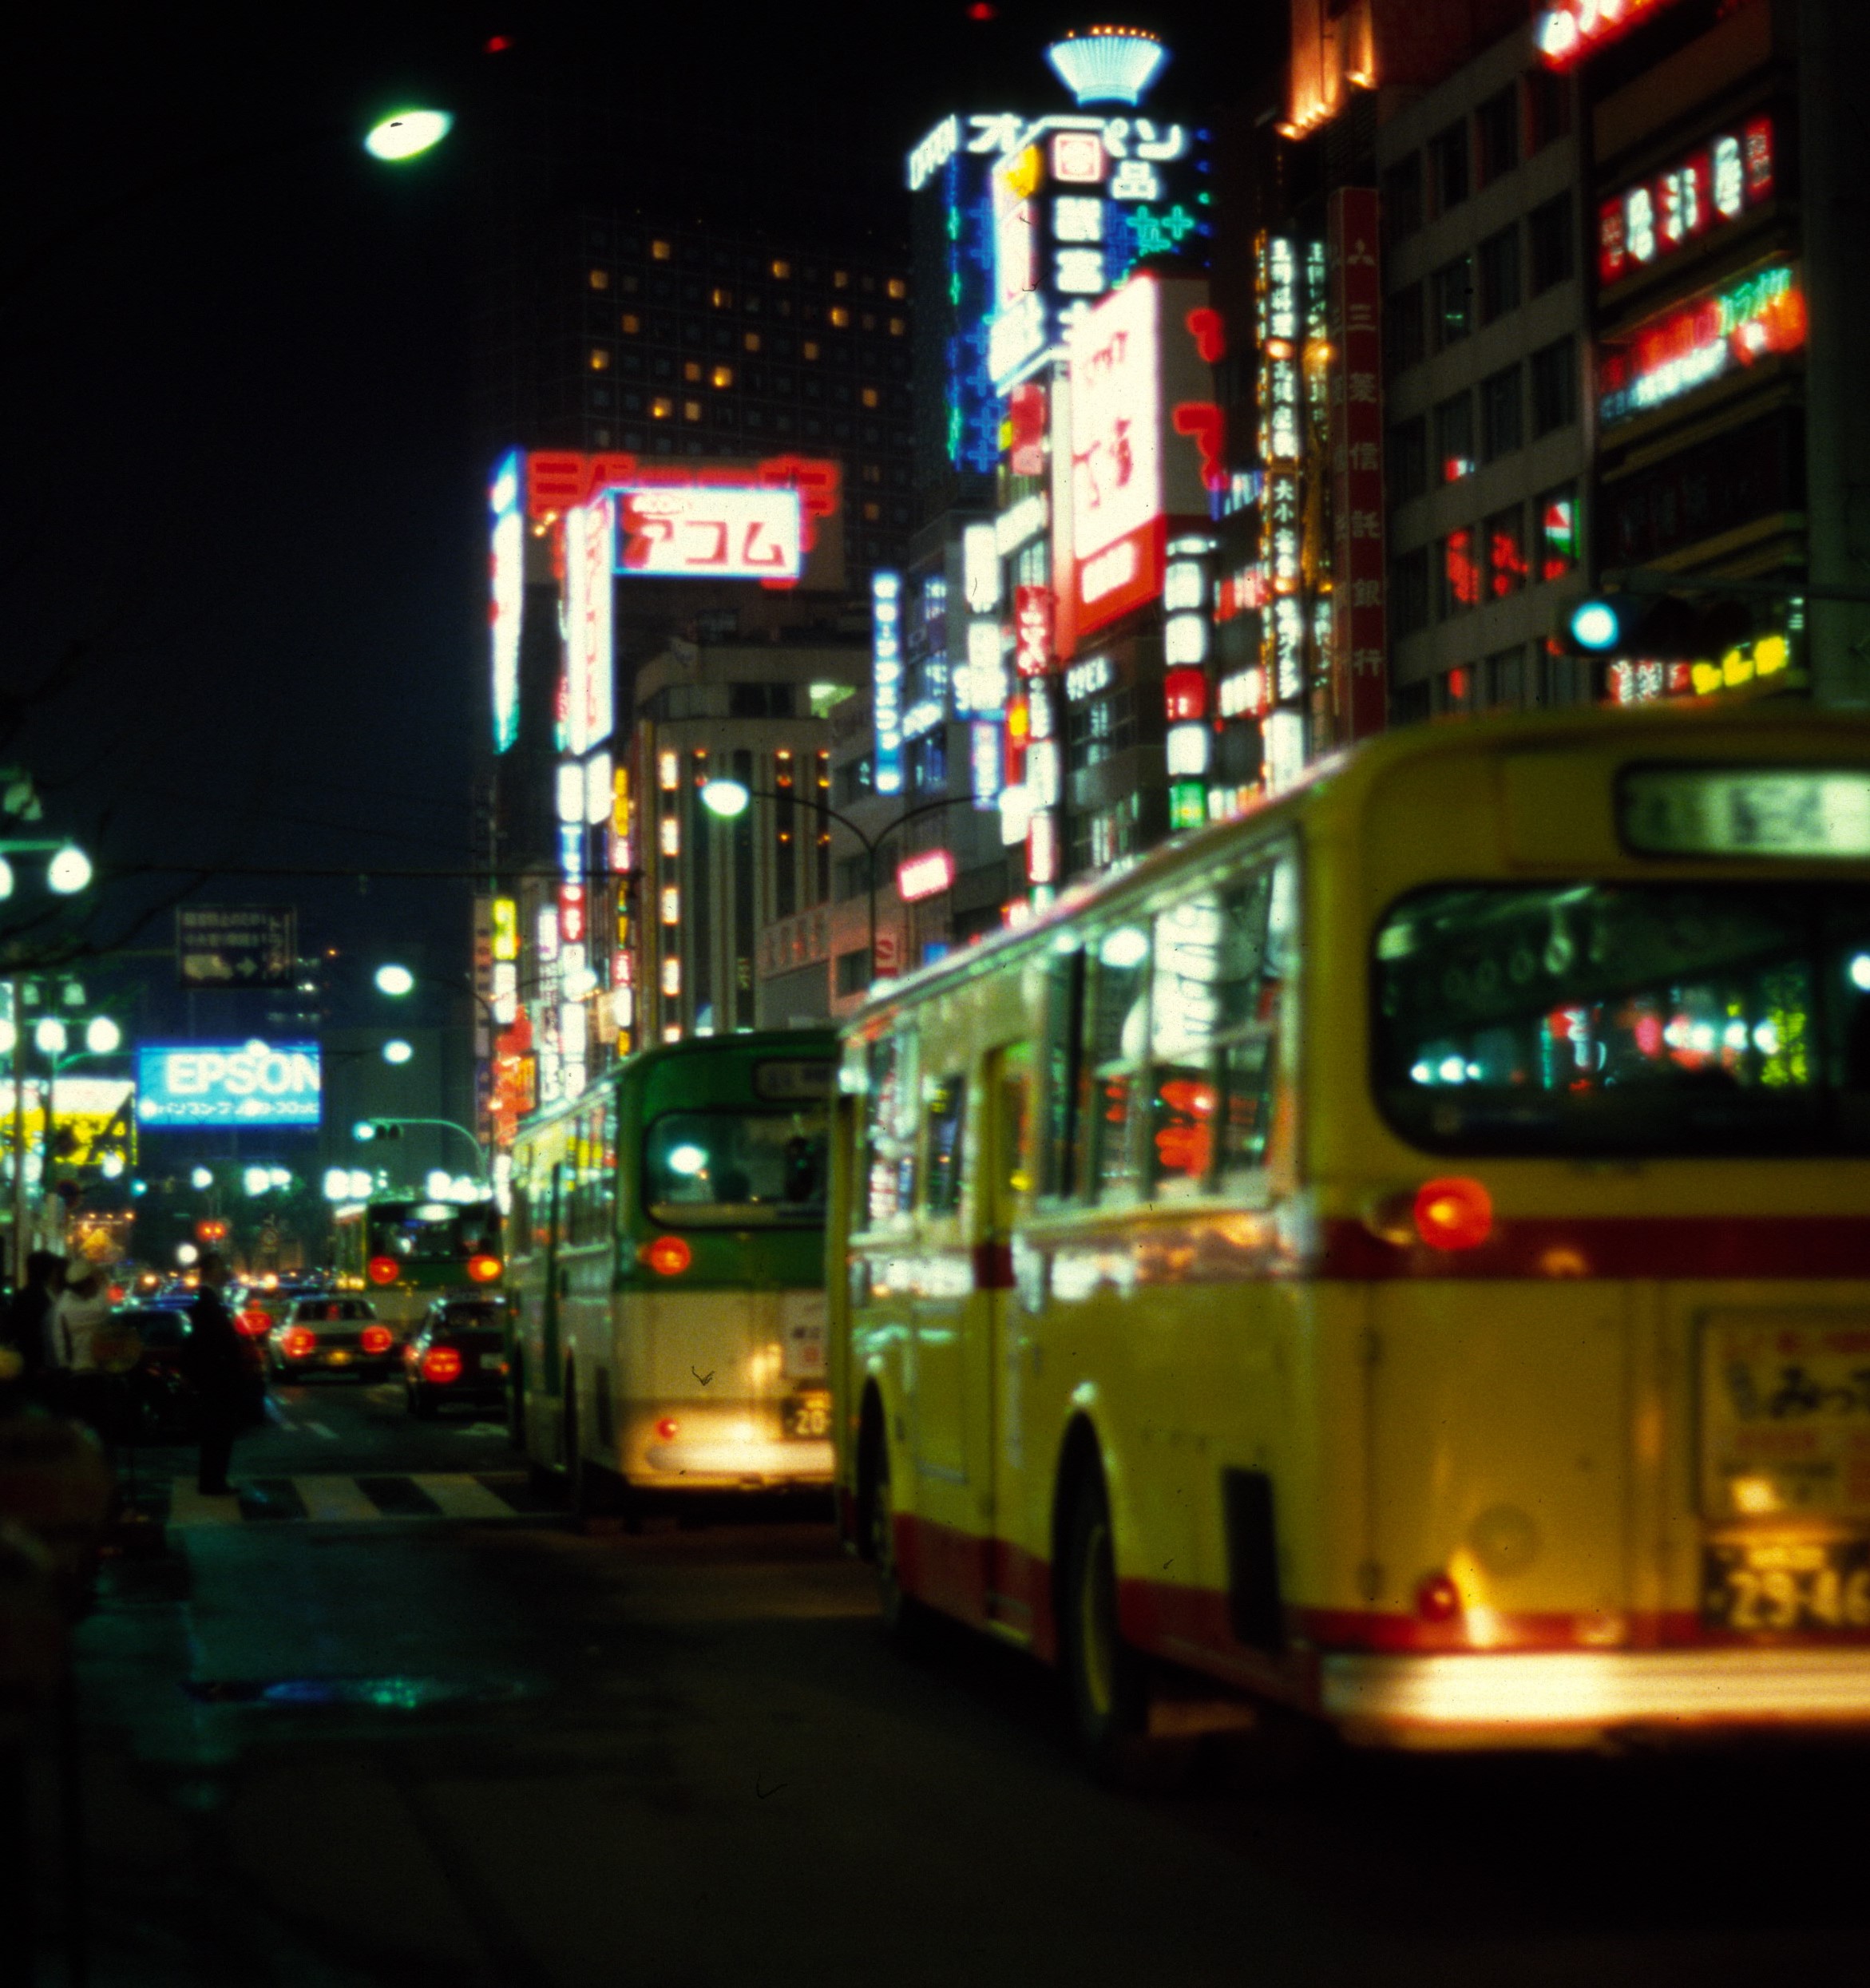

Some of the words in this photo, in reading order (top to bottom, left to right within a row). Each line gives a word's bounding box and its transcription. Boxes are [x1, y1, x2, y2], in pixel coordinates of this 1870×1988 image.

[1346, 303, 1383, 677] 三菱信託銀行
[623, 516, 786, 568] アコム
[165, 1051, 321, 1096] EPSON
